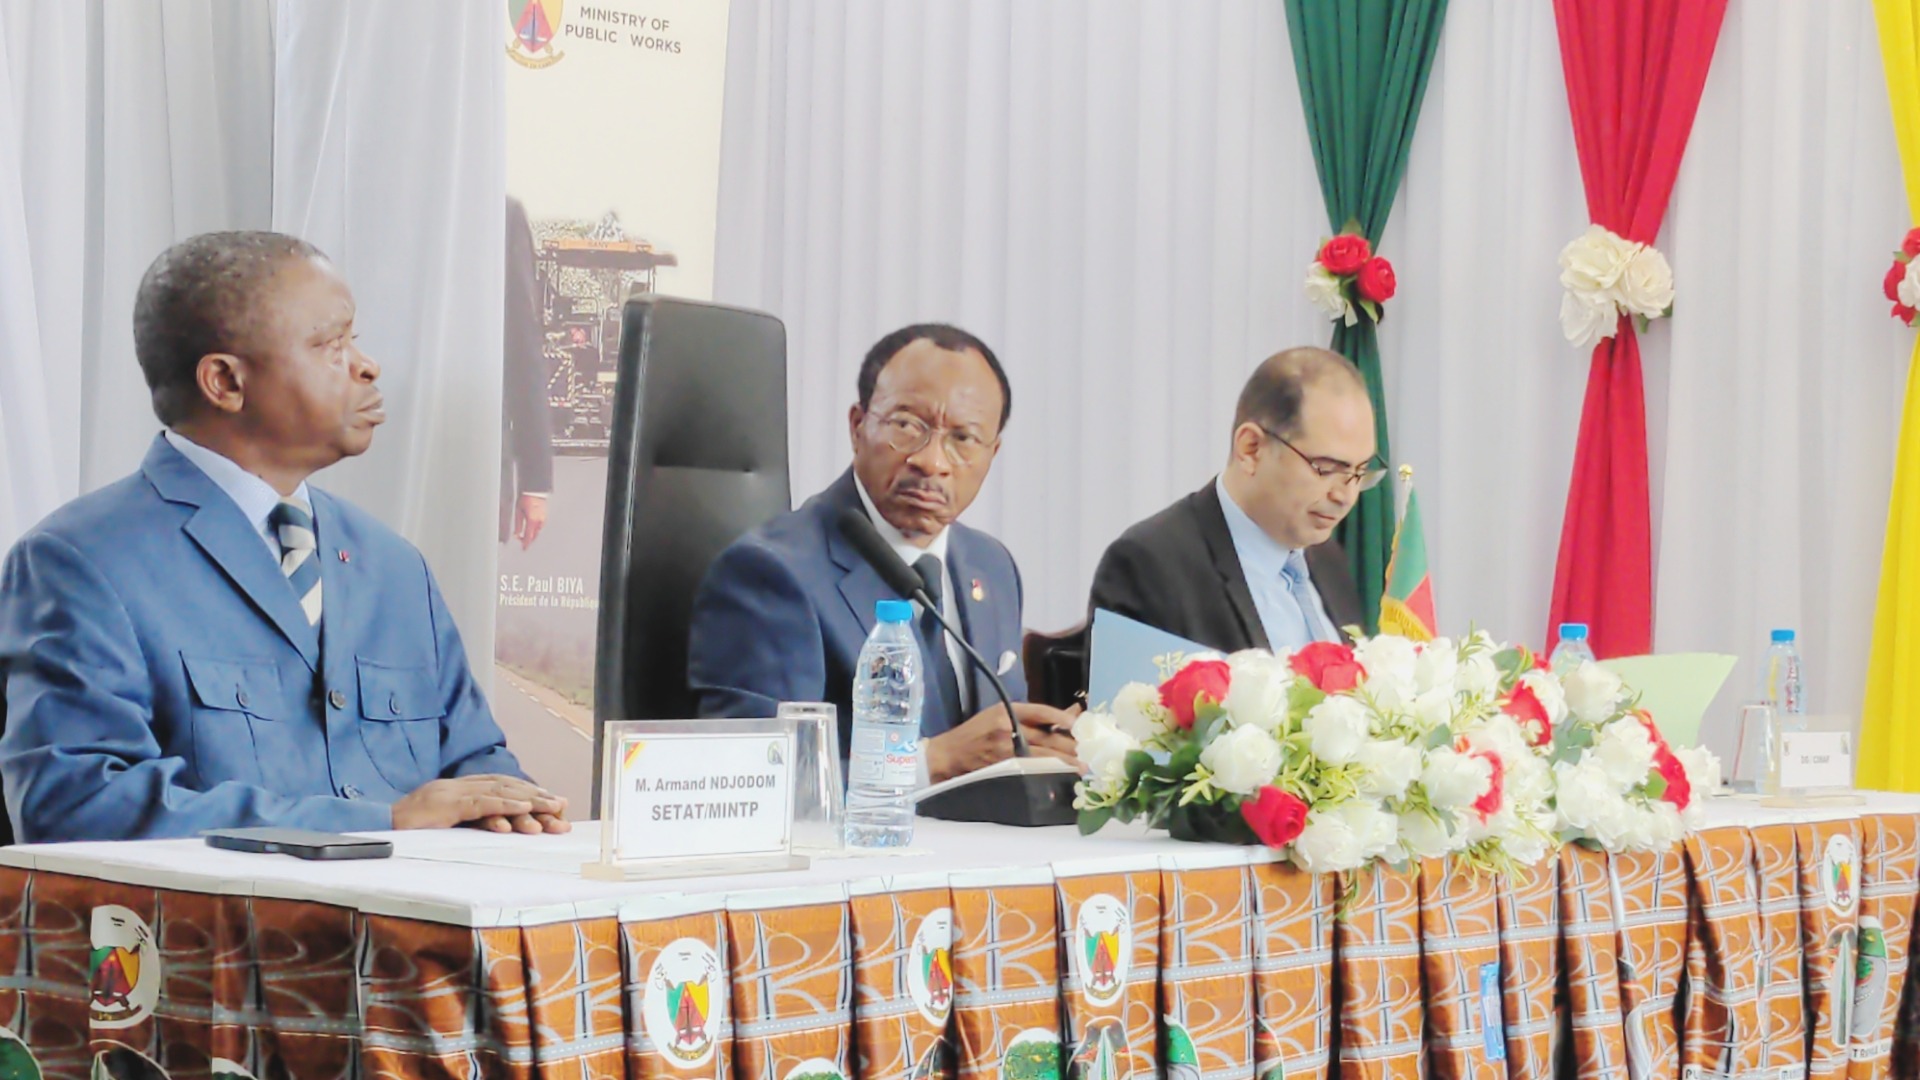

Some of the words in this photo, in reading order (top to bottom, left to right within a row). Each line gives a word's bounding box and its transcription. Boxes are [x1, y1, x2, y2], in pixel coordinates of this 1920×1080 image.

[580, 6, 647, 28] MINISTRY
[651, 18, 670, 32] OF
[565, 24, 617, 43] PUBLIC
[631, 34, 681, 54] WORKS
[500, 575, 523, 592] S.E.
[527, 576, 553, 593] Paul
[557, 577, 583, 594] BIYA
[500, 593, 537, 607] Président
[539, 596, 549, 607] de
[551, 596, 558, 607] la
[560, 596, 599, 610] Républiqu
[635, 779, 651, 792] M.
[655, 777, 706, 792] Armand
[710, 775, 776, 790] NDJODOM
[652, 801, 759, 821] SETAT/MINTP
